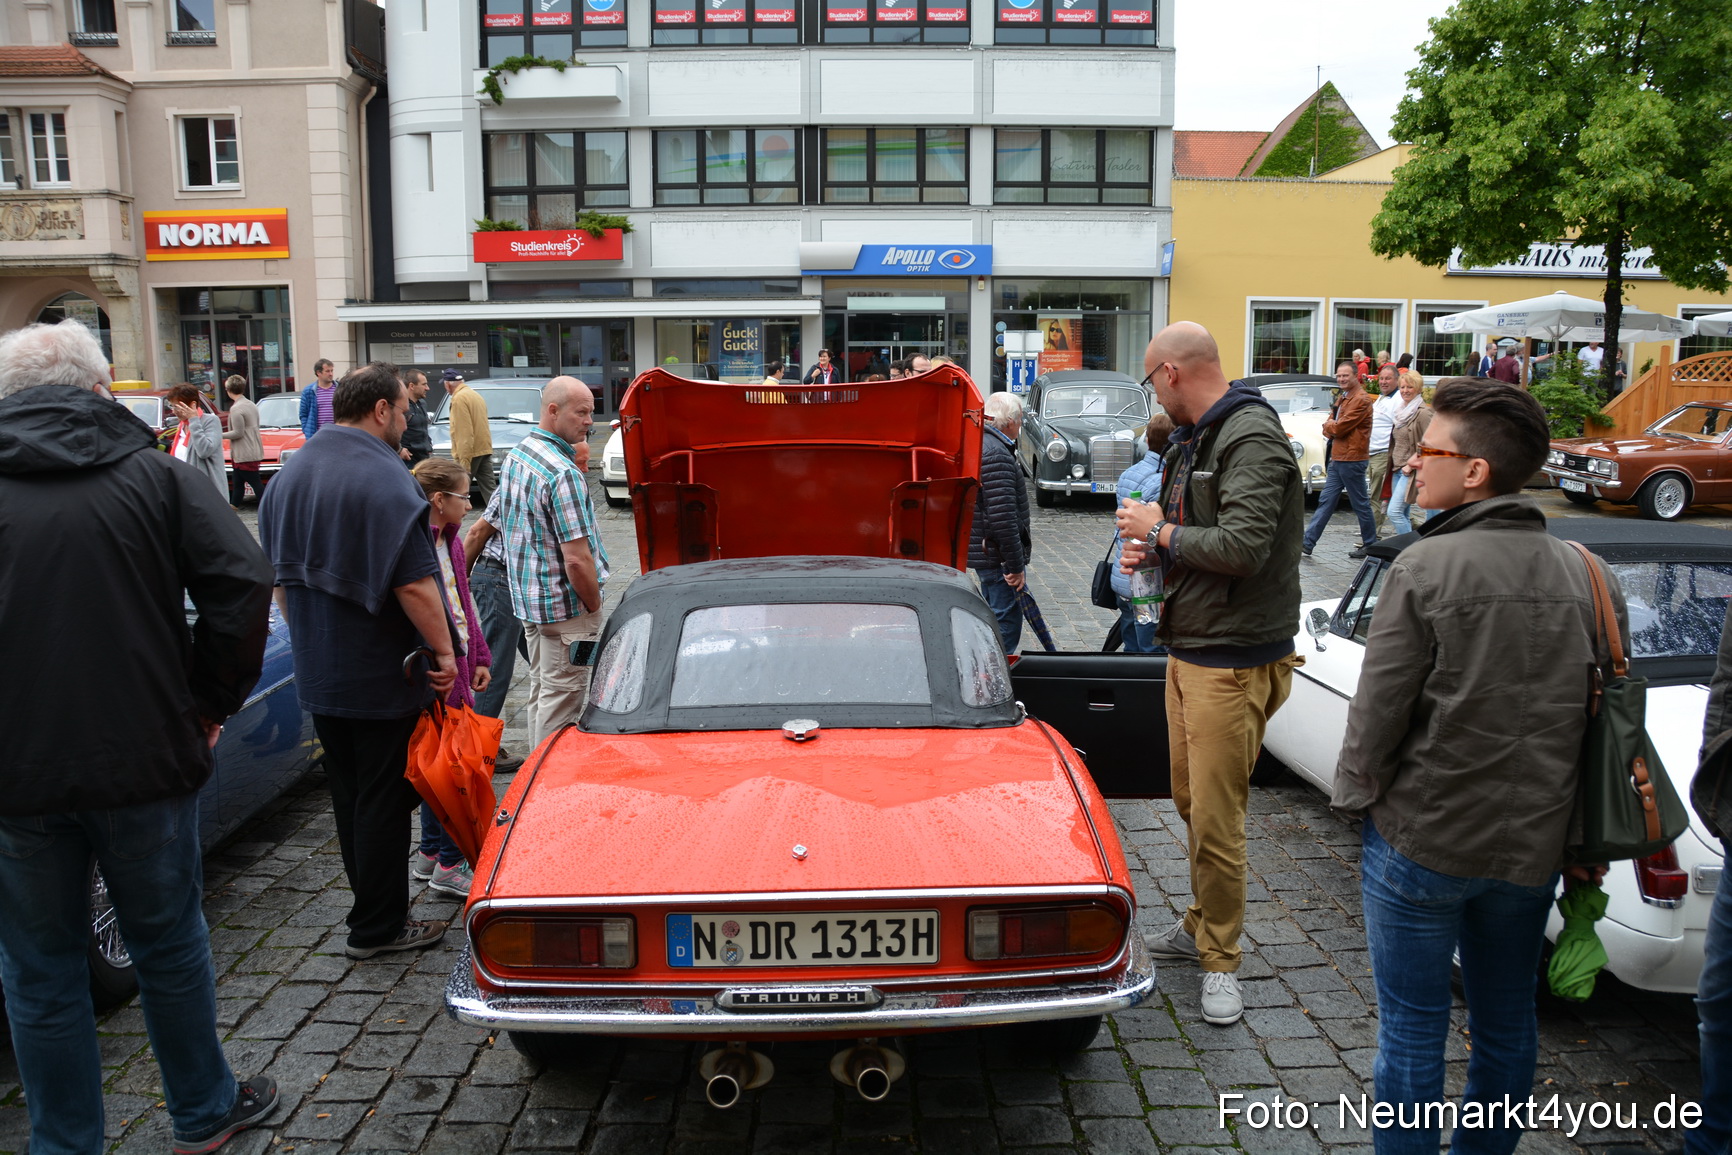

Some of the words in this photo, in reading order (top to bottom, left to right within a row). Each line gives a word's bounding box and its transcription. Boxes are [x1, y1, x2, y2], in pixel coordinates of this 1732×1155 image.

[1051, 156, 1096, 171] Katrin
[1105, 156, 1142, 171] Tasler
[158, 222, 271, 247] NORMA
[510, 241, 572, 252] Studienkreis
[881, 247, 936, 265] APOLLO
[723, 327, 758, 338] Guck!
[723, 340, 758, 351] Guck!
[694, 922, 716, 960] N
[749, 920, 797, 960] DR
[812, 918, 934, 958] 1313H
[676, 946, 686, 957] D
[740, 992, 858, 1002] TRIUMPH
